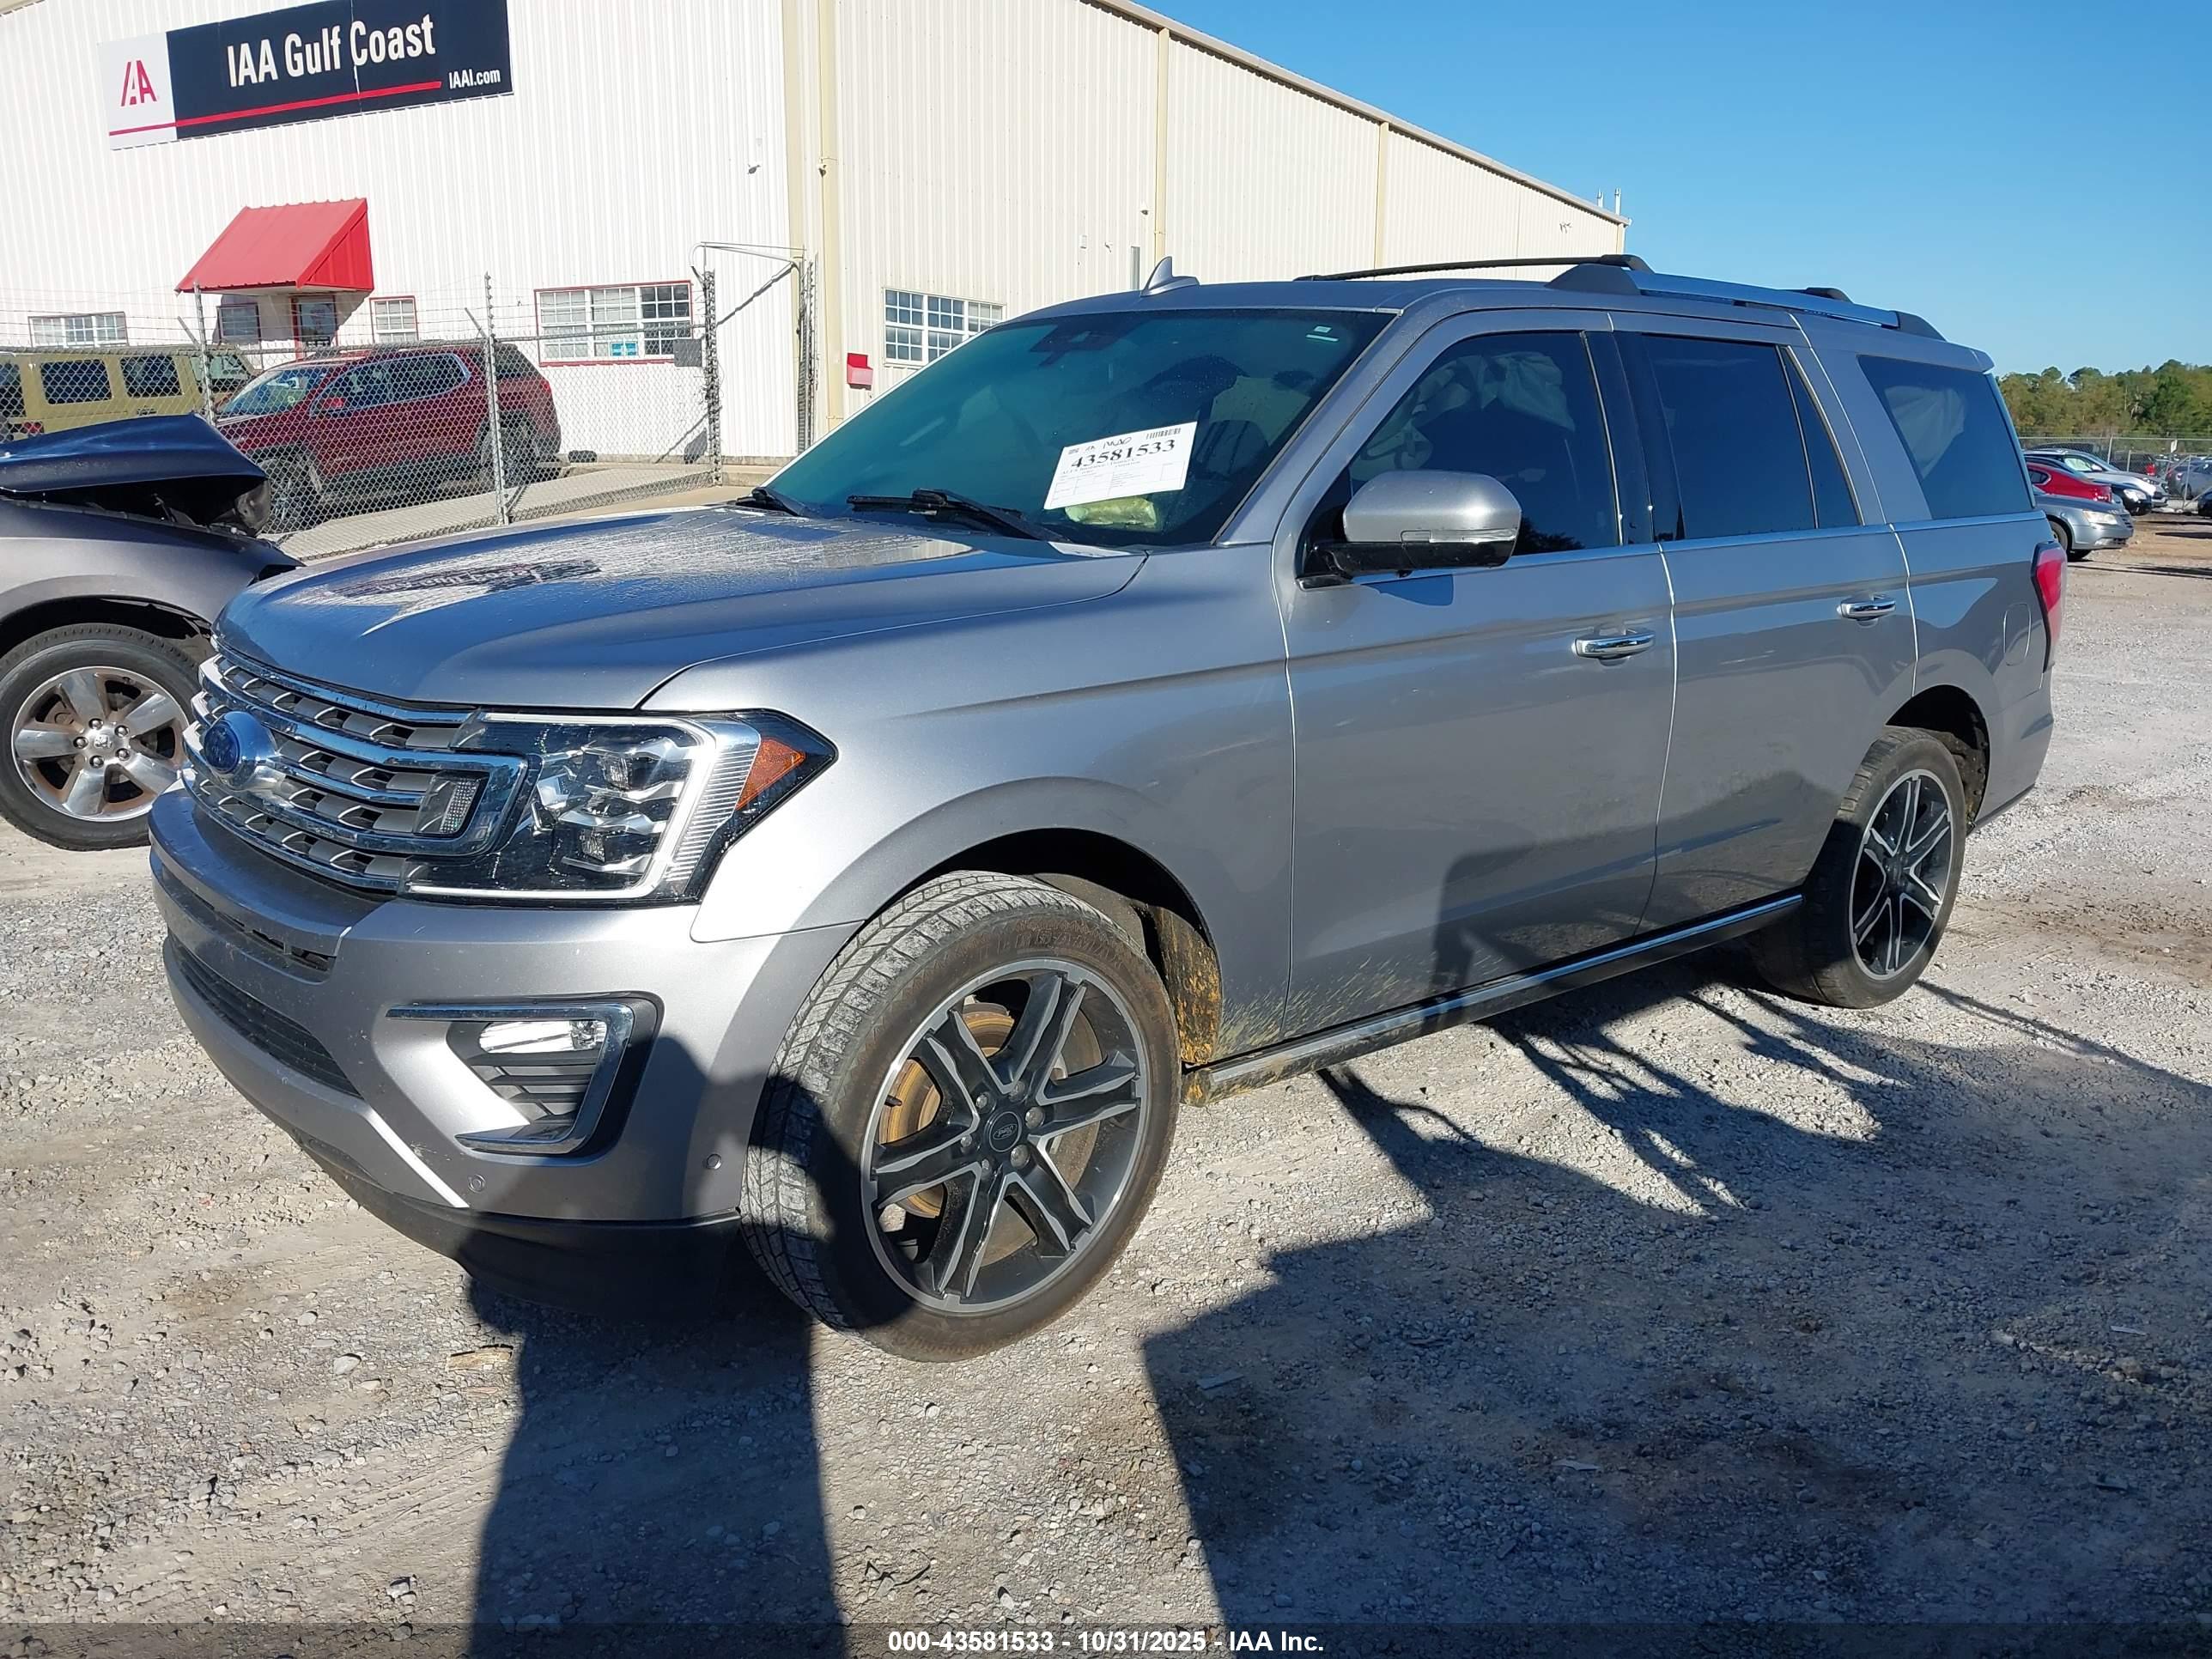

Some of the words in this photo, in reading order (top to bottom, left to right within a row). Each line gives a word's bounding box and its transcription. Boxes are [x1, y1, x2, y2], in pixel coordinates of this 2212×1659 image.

[228, 39, 279, 88] IAA
[284, 25, 341, 77] Gulf
[349, 14, 436, 66] Coast
[448, 68, 501, 89] IAAI.com
[1071, 439, 1176, 468] 43581533
